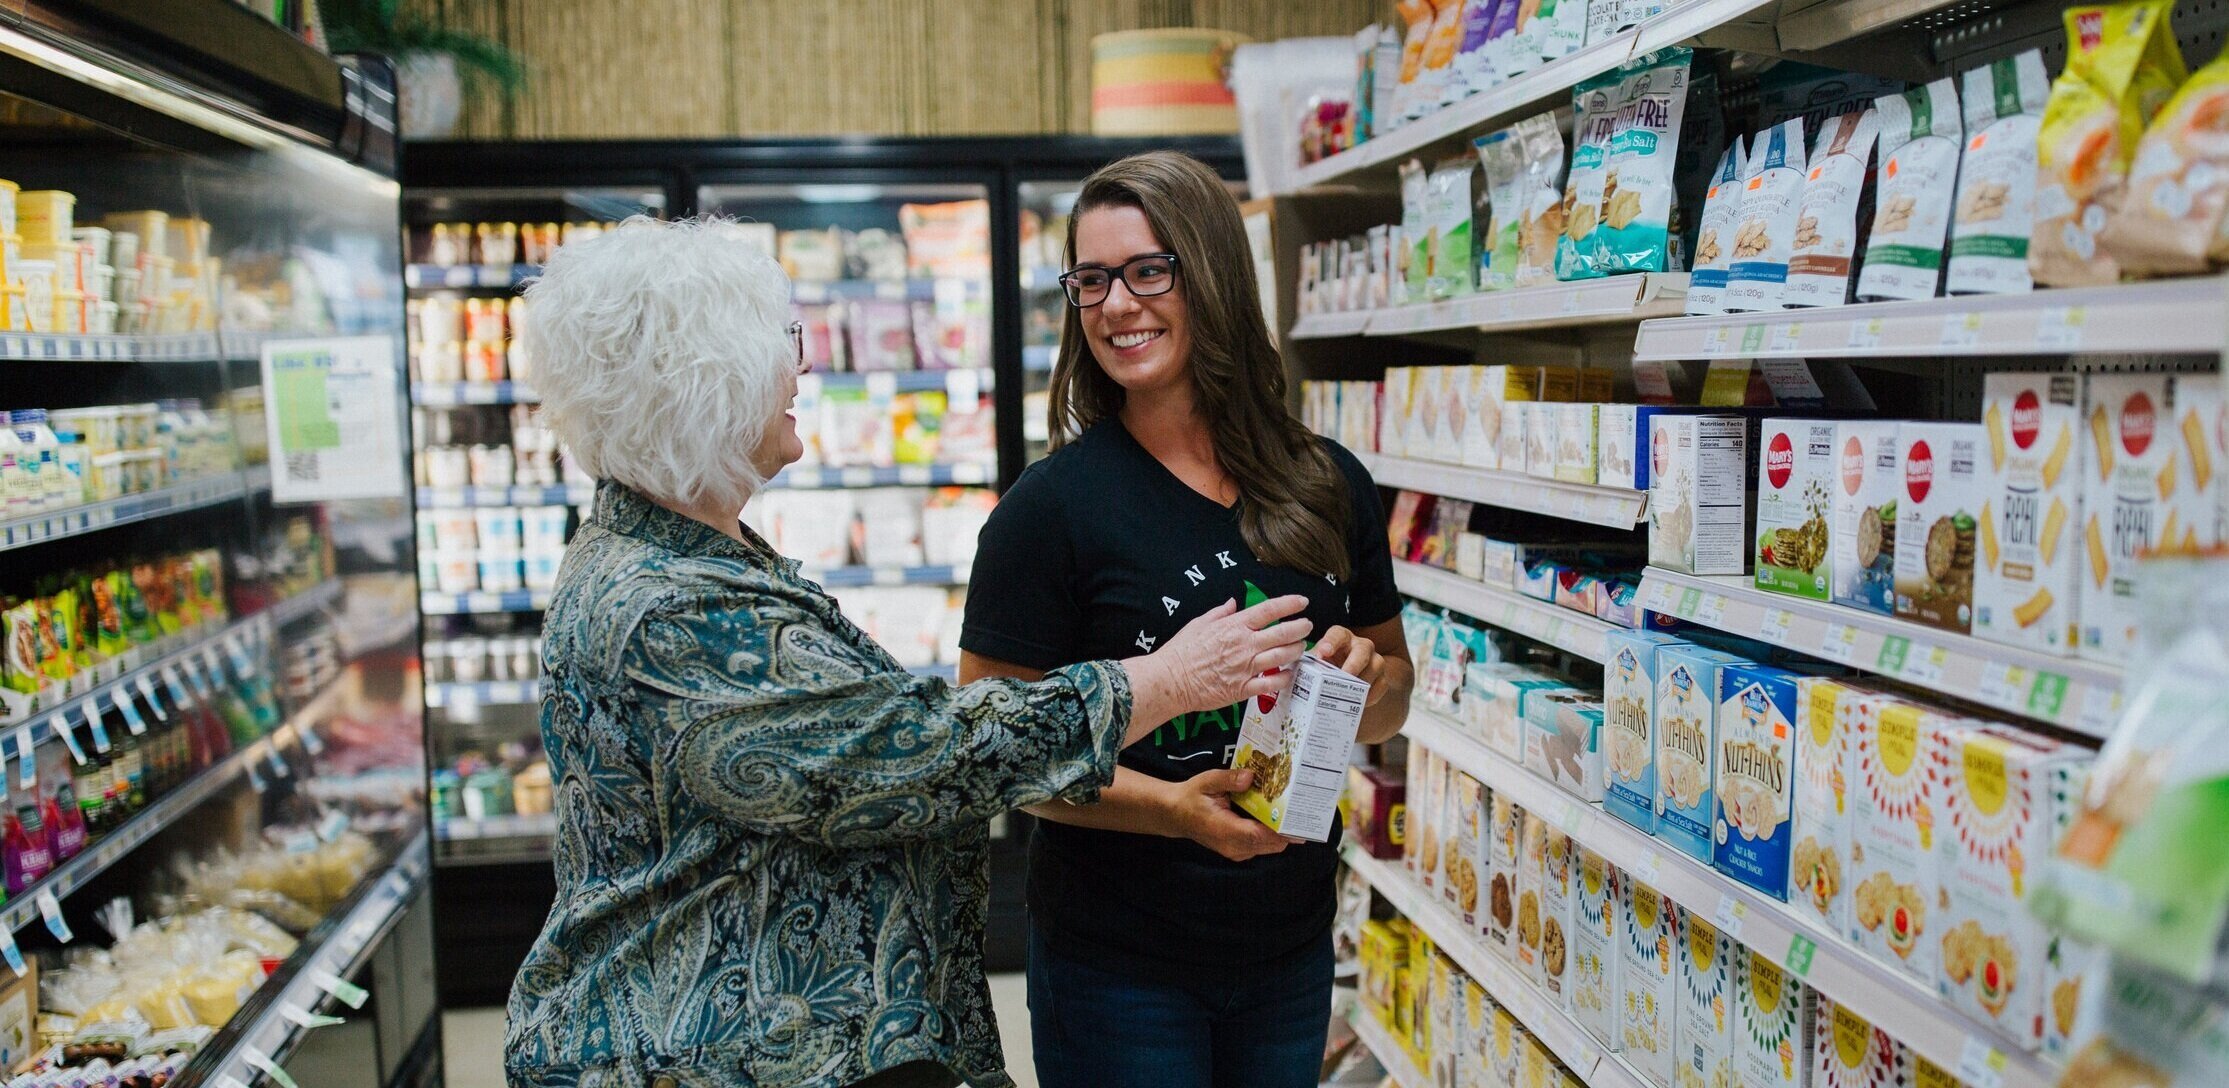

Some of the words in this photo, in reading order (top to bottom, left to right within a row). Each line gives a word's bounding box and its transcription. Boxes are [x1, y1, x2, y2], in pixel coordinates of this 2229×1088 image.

[1634, 98, 1670, 128] FREE
[1632, 134, 1655, 149] Salt
[1768, 449, 1793, 465] MARY'S
[1323, 679, 1348, 689] Nutrition
[1636, 886, 1657, 905] SIMPLE
[1692, 923, 1713, 946] SIMPLE
[1753, 959, 1780, 987] SIMPLE
